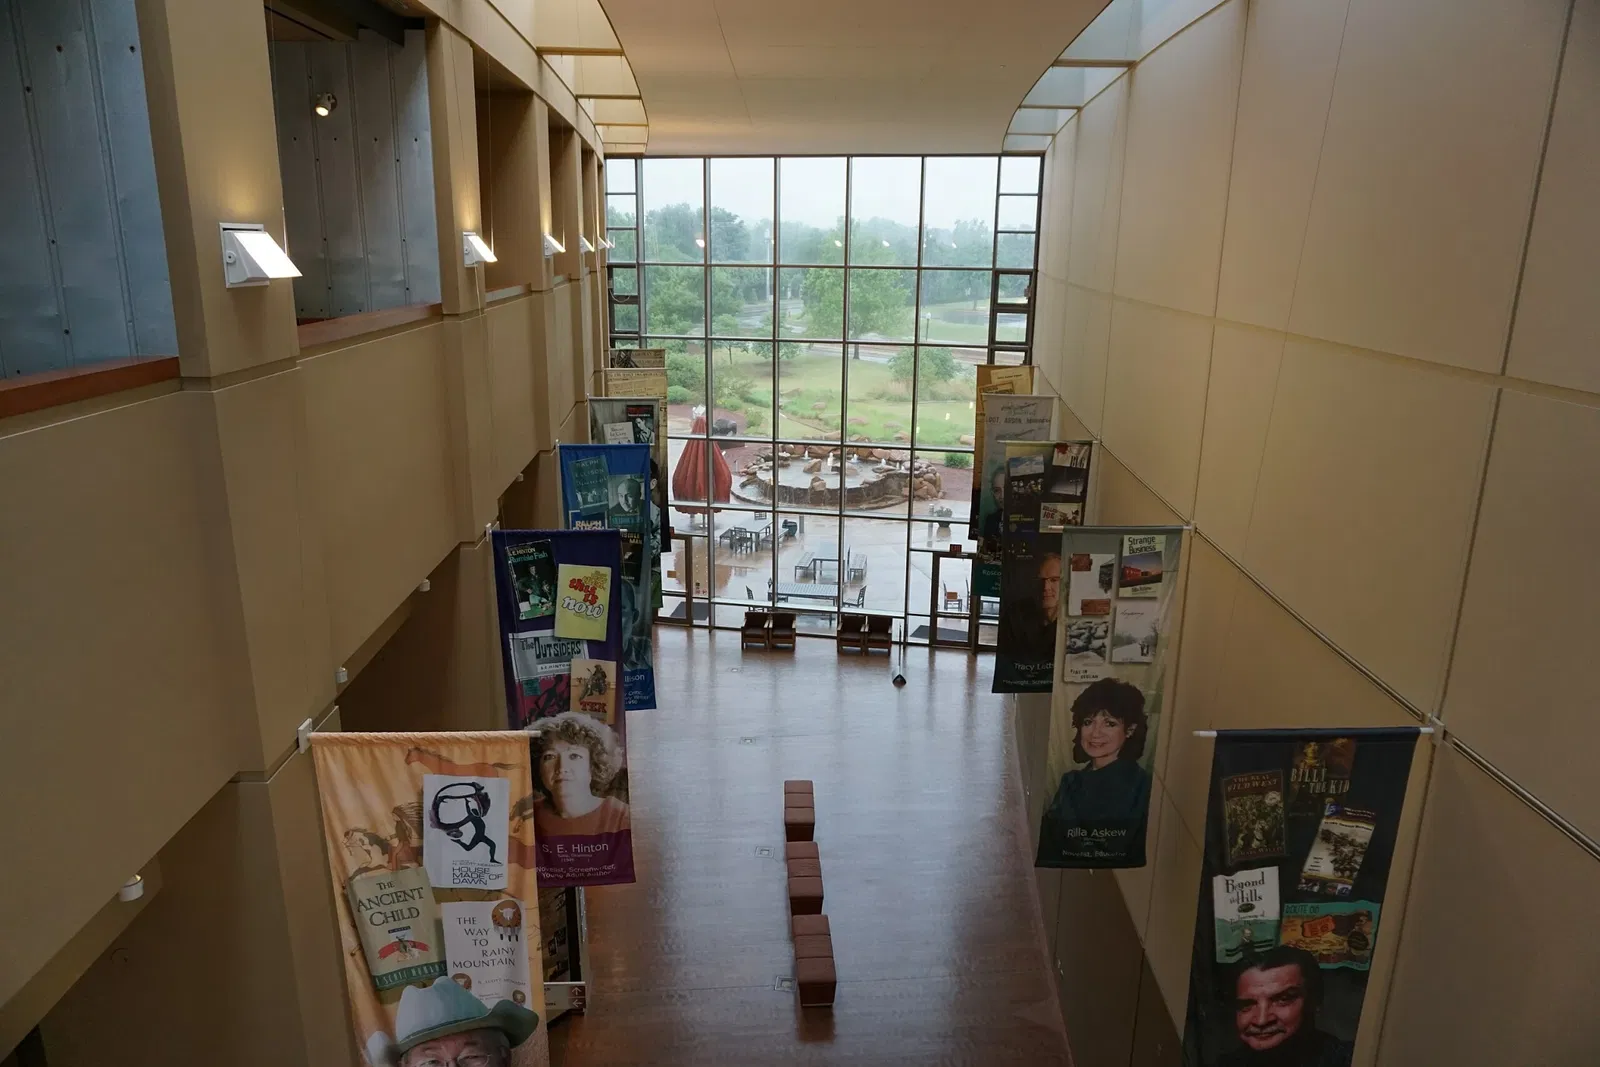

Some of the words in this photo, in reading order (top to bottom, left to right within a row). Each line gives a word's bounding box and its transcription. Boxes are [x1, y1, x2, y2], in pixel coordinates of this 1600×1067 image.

[576, 520, 602, 529] RALPH
[1128, 535, 1156, 546] Strange
[1128, 544, 1156, 554] Business
[533, 550, 549, 560] Fish
[562, 596, 604, 618] now
[520, 639, 534, 651] The
[1014, 662, 1035, 671] Tracy
[625, 674, 645, 683] llison
[1290, 767, 1328, 783] BILLY
[1309, 781, 1328, 794] THE
[1329, 779, 1350, 794] KID
[1067, 827, 1088, 838] Rilla
[1090, 827, 1127, 838] Askew
[541, 843, 552, 853] S.
[556, 844, 567, 854] E.
[571, 843, 609, 853] Hinton
[452, 866, 490, 875] HOUSE
[452, 872, 485, 880] MADE
[488, 873, 504, 881] OF
[376, 881, 395, 891] THE
[452, 878, 488, 886] DAWN
[1225, 871, 1265, 894] Beyond
[356, 886, 424, 913] ANCIENT
[1236, 888, 1263, 905] Hills
[369, 906, 420, 927] CHILD
[457, 917, 476, 925] THE
[464, 928, 490, 936] WAY
[472, 938, 488, 946] TO
[481, 947, 516, 957] RAINY
[452, 958, 516, 969] MOUNTAIN
